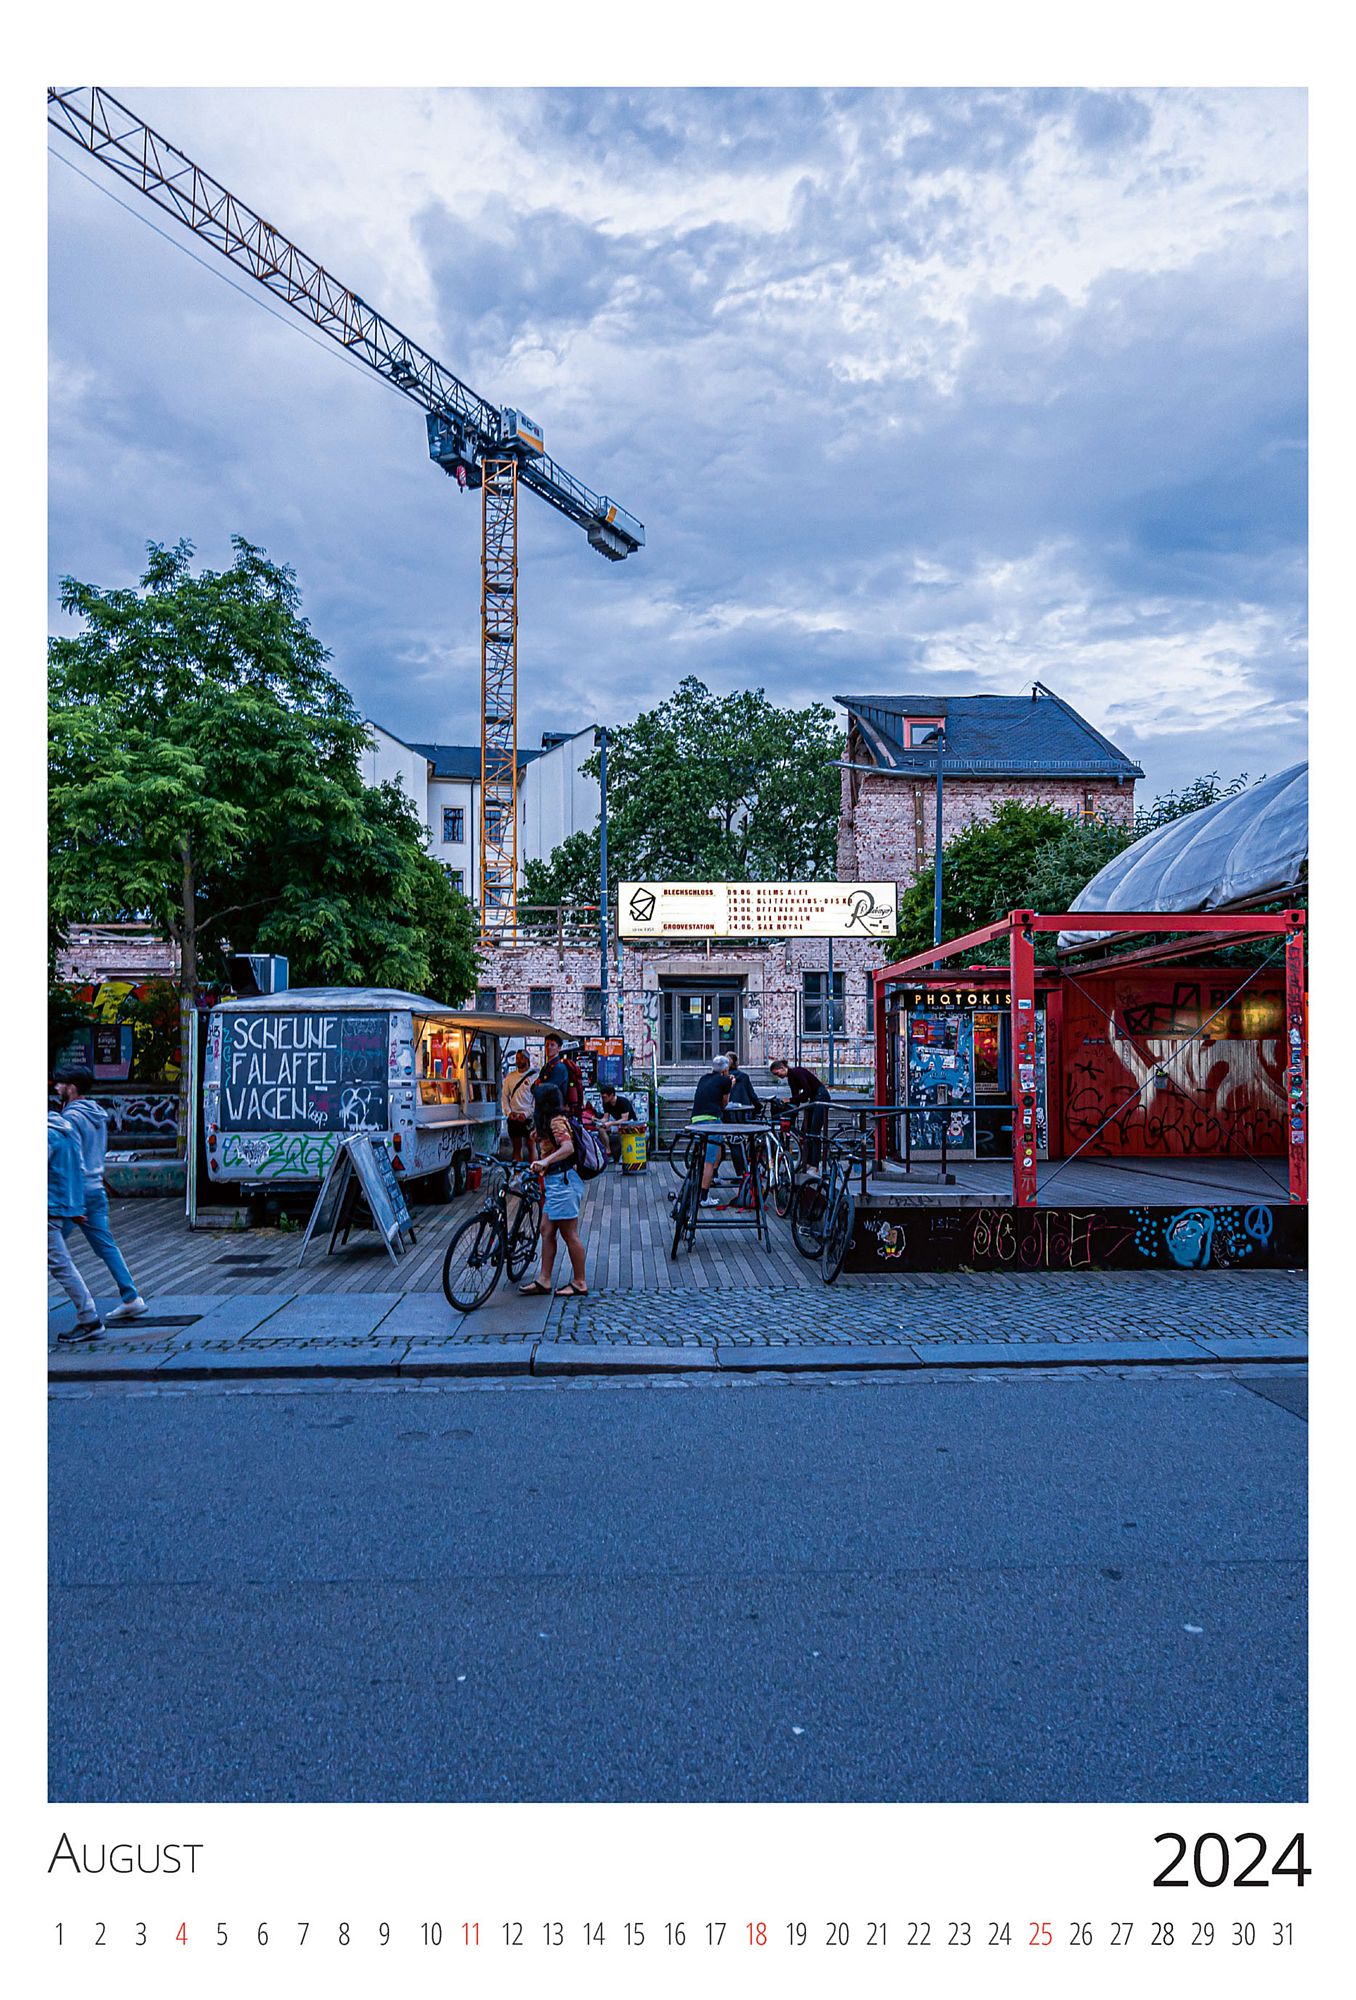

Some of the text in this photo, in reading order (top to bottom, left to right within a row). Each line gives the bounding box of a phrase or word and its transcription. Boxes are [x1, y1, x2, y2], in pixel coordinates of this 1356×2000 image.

[233, 1017, 338, 1050] SCHEUNE
[232, 1053, 337, 1085] FALAFEL
[225, 1087, 307, 1121] WAGEN
